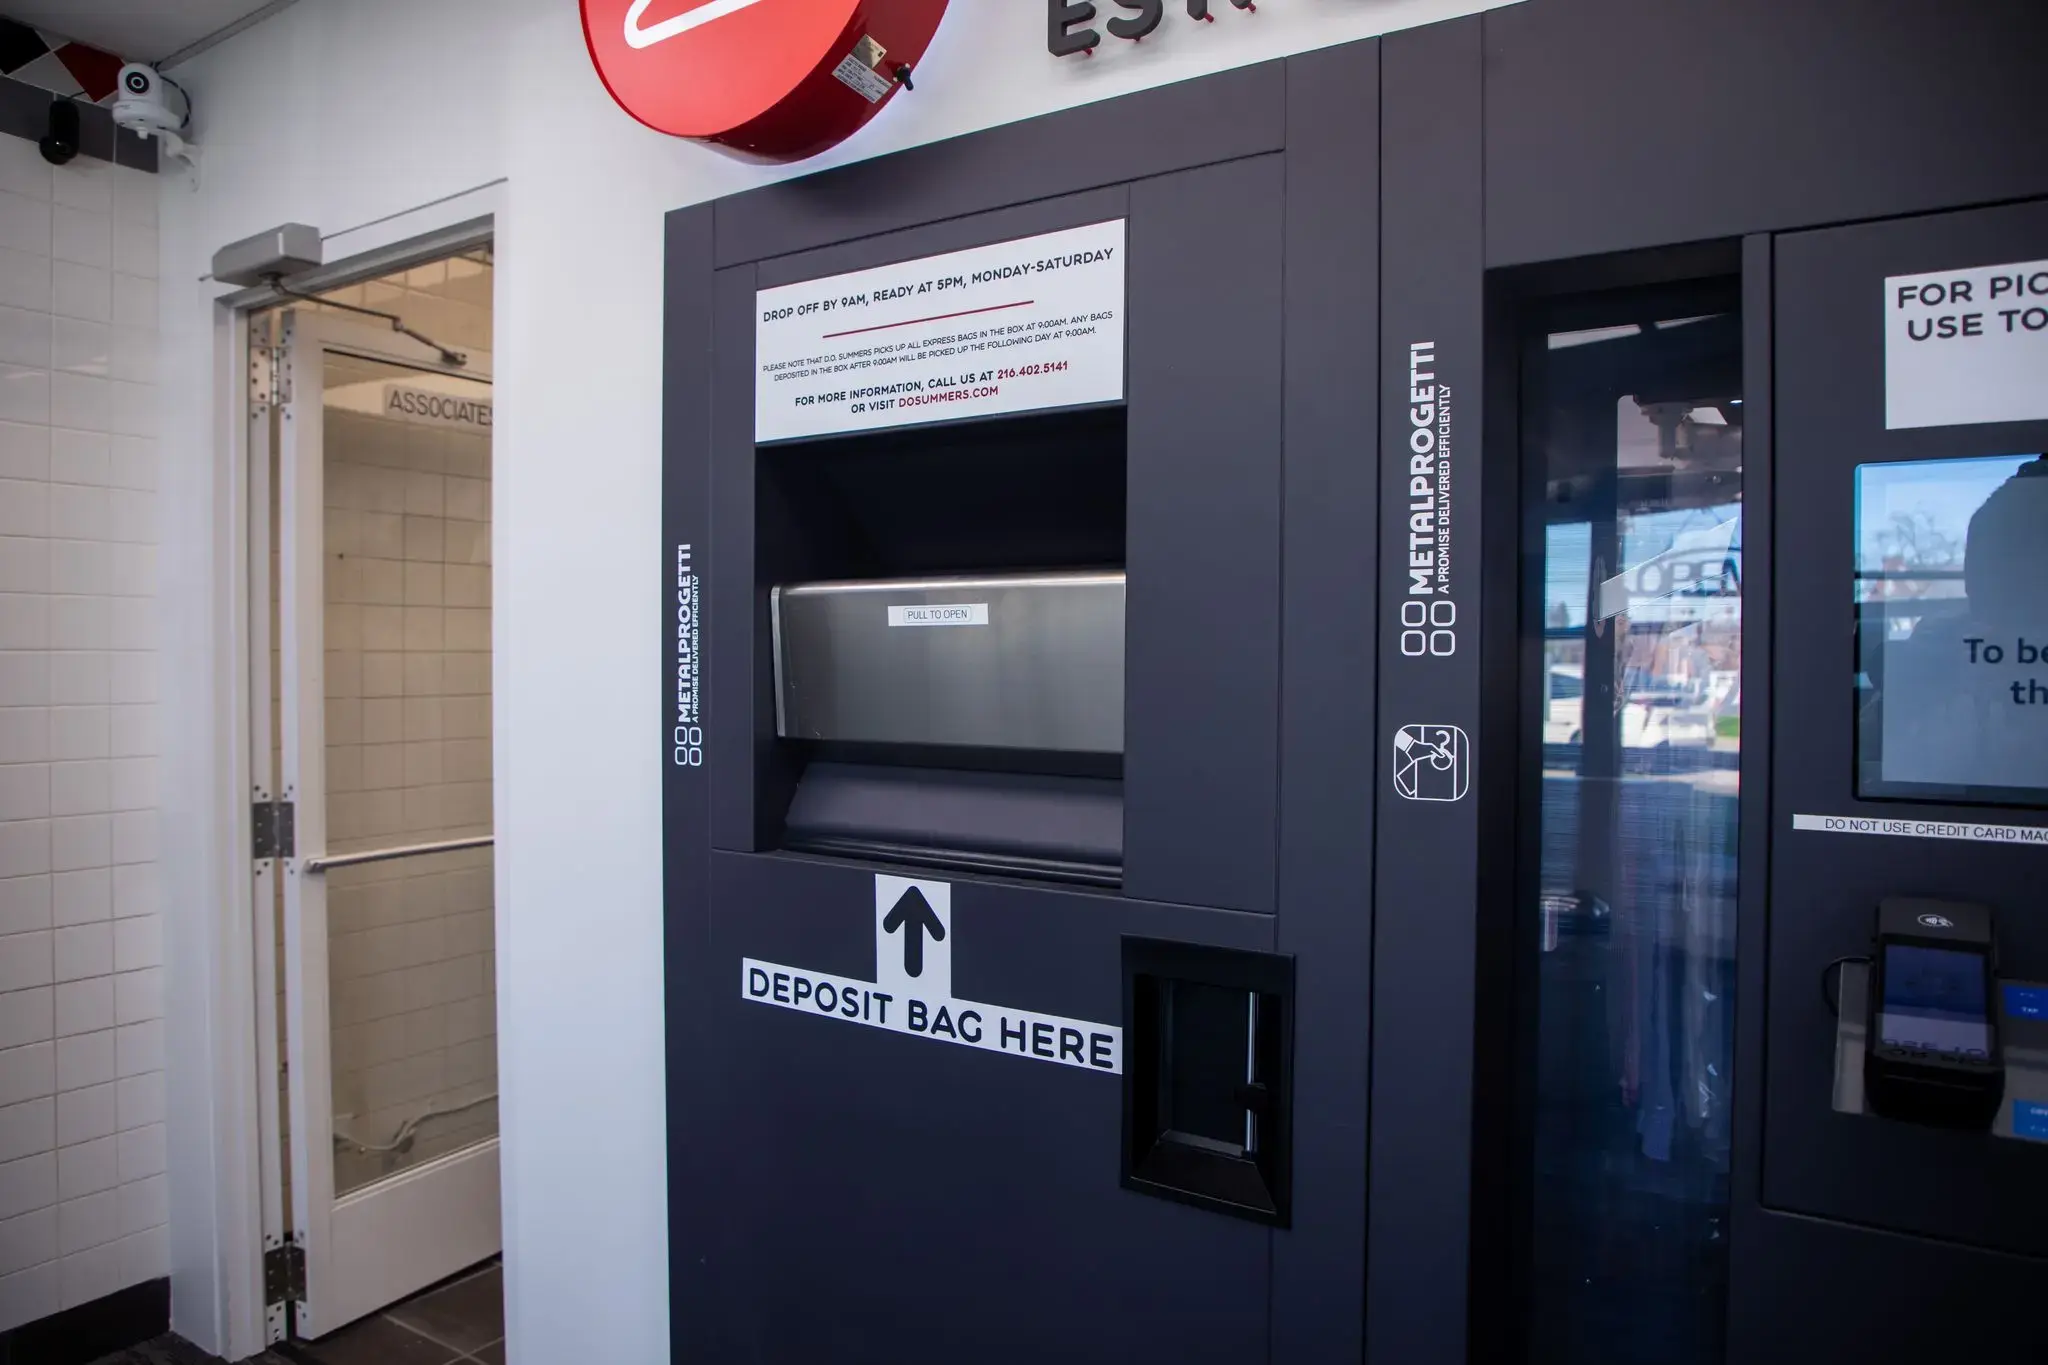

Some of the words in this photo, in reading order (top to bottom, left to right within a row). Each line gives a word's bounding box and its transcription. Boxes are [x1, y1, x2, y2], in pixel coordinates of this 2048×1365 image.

[763, 308, 794, 322] DROP
[797, 302, 819, 315] OFF
[823, 299, 838, 311] BY
[842, 294, 869, 307] 9AM,
[873, 285, 914, 301] READY
[918, 281, 933, 294] AT
[937, 276, 967, 290] 5PM,
[972, 248, 1113, 284] MONDAY-SATURDAY
[1898, 279, 1973, 309] FOR
[763, 362, 786, 372] PLEASE
[787, 359, 805, 368] NOTE
[806, 357, 822, 365] THAT
[838, 349, 872, 360] SUMMERS
[874, 345, 894, 355] PICKS
[895, 343, 906, 352] UP
[908, 341, 921, 349] ALL
[922, 335, 956, 347] EXPRESS
[958, 333, 977, 342] BAGS
[990, 328, 1005, 336] THE
[1007, 325, 1024, 334] BOX
[1026, 323, 1036, 331] AT
[1070, 315, 1089, 324] ANY
[1091, 311, 1113, 321] BAGS
[1908, 312, 1984, 341] USE
[1998, 306, 2048, 332] TO
[774, 369, 809, 382] DEPOSITED
[819, 366, 832, 374] THE
[834, 363, 849, 372] BOX
[849, 360, 871, 370] AFTER
[899, 354, 915, 362] WILL
[928, 343, 955, 360] PICKED
[957, 345, 969, 354] UP
[970, 343, 985, 351] THE
[987, 336, 1033, 349] FOLLOWING
[1034, 334, 1052, 342] DAY
[1053, 331, 1063, 339] AT
[795, 397, 815, 406] FOR
[818, 391, 846, 404] MORE
[850, 380, 925, 399] INFORMATION,
[928, 375, 956, 389] CALL
[960, 373, 975, 384] US
[979, 371, 994, 381] AT
[997, 361, 1068, 379] 216.402.5141
[851, 403, 866, 413] OR
[868, 399, 895, 411] VISIT
[899, 386, 999, 408] DOSUMMERS.COM
[389, 389, 493, 426] ASSOCIATE
[1439, 383, 1451, 458] EFFICIENTLY
[1409, 341, 1435, 595] METALPROGETTI
[1438, 460, 1450, 525] DELIVERED
[1437, 527, 1450, 582] PROMISE
[1437, 584, 1450, 594] A
[678, 544, 691, 723] METALPROGETTI
[907, 610, 928, 620] PULL
[930, 610, 942, 619] TO
[943, 609, 968, 619] OPEN
[1963, 638, 2004, 664] To
[2010, 678, 2048, 705] th
[1825, 818, 1846, 830] DO
[1849, 820, 1879, 833] NOT
[1883, 822, 1912, 834] USE
[1915, 824, 1970, 837] CREDIT
[1973, 827, 2017, 840] CARD
[749, 967, 894, 1024] DEPOSIT
[907, 998, 983, 1043] BAG
[1000, 1015, 1115, 1069] HERE
